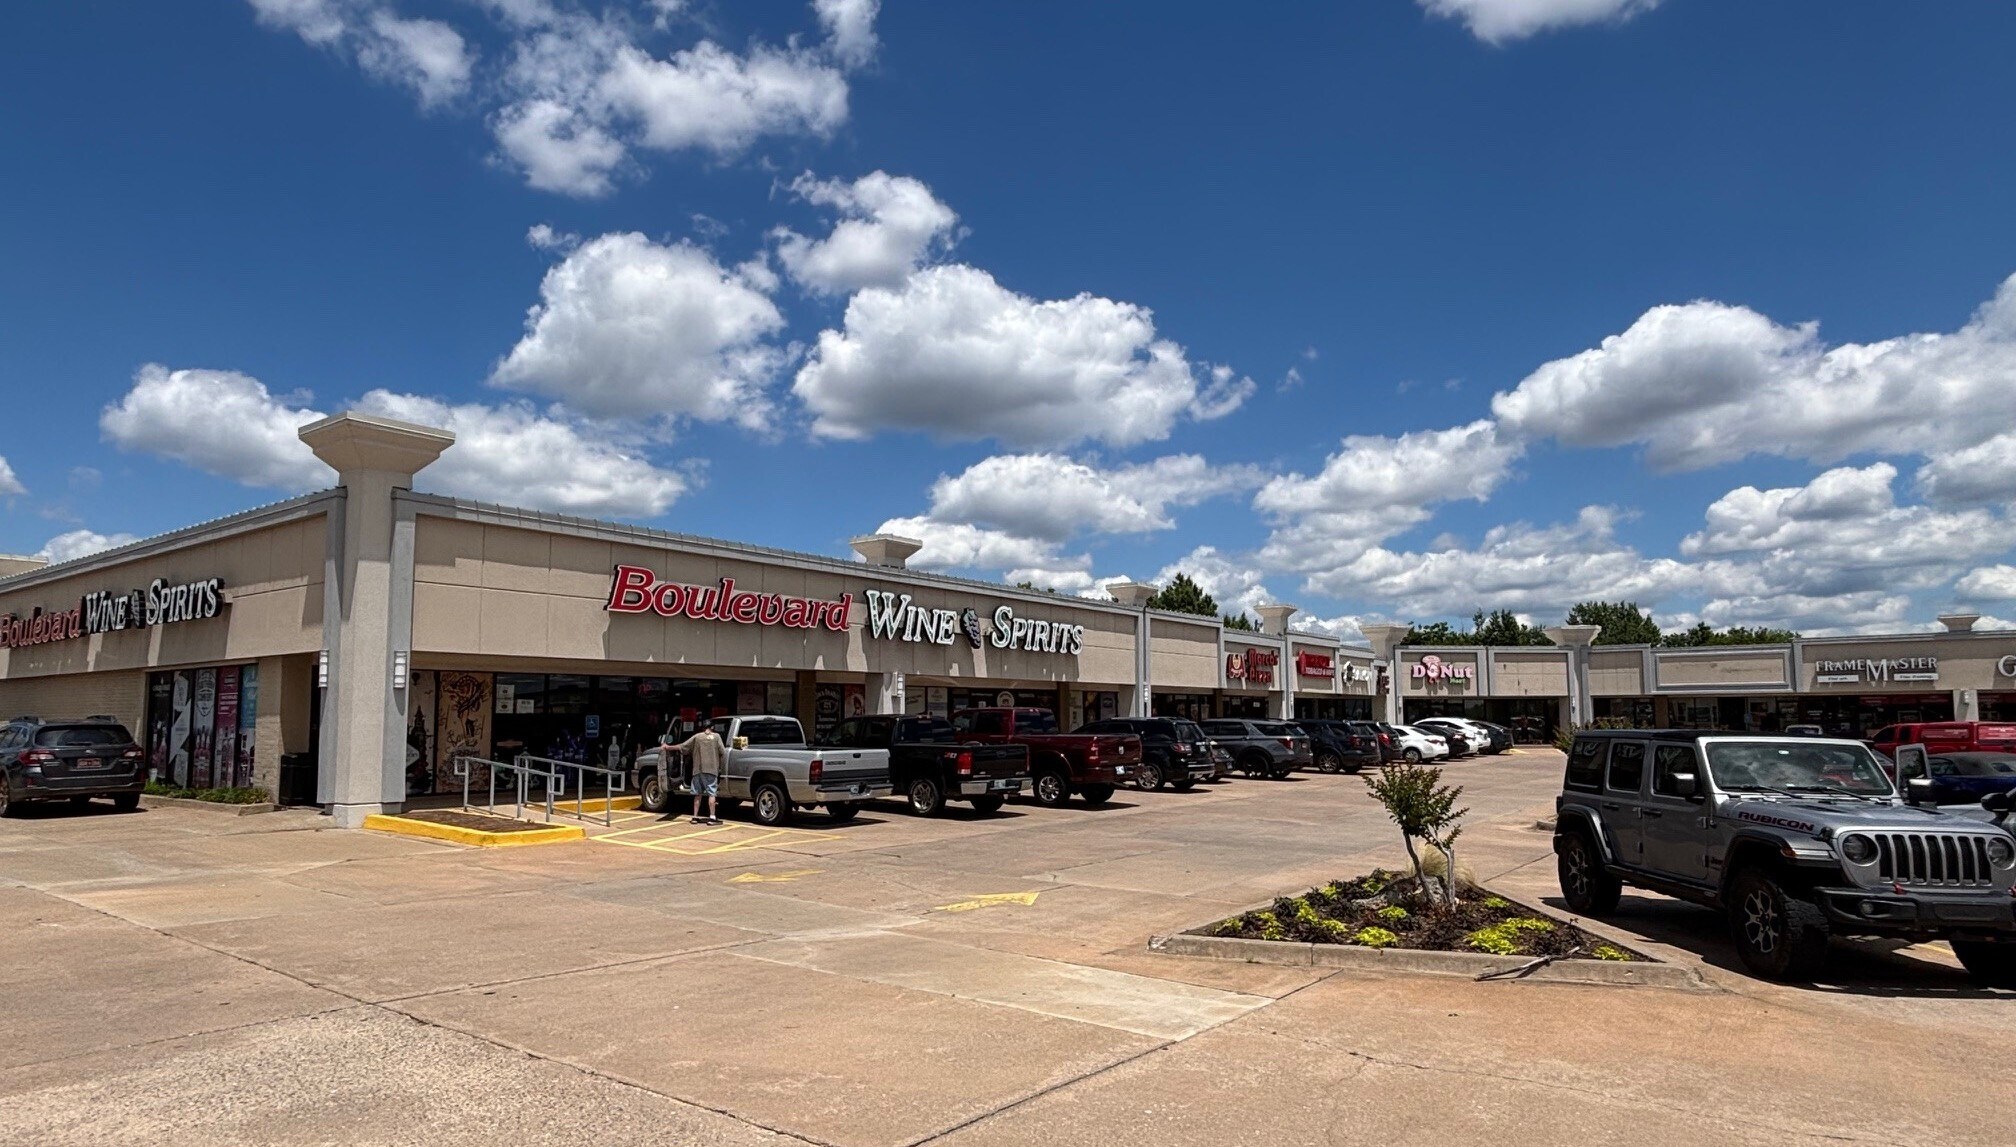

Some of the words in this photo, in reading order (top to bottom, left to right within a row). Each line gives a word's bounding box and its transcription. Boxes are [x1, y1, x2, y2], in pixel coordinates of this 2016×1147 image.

[0, 600, 82, 648] Boulevard
[85, 590, 129, 634] WINE
[146, 578, 219, 626] SPIRITS
[607, 565, 853, 631] Boulevard
[865, 589, 957, 646] WINE
[991, 605, 1084, 655] SPIRITS
[1249, 667, 1272, 684] Pizza
[1738, 811, 1815, 832] RUBICON
